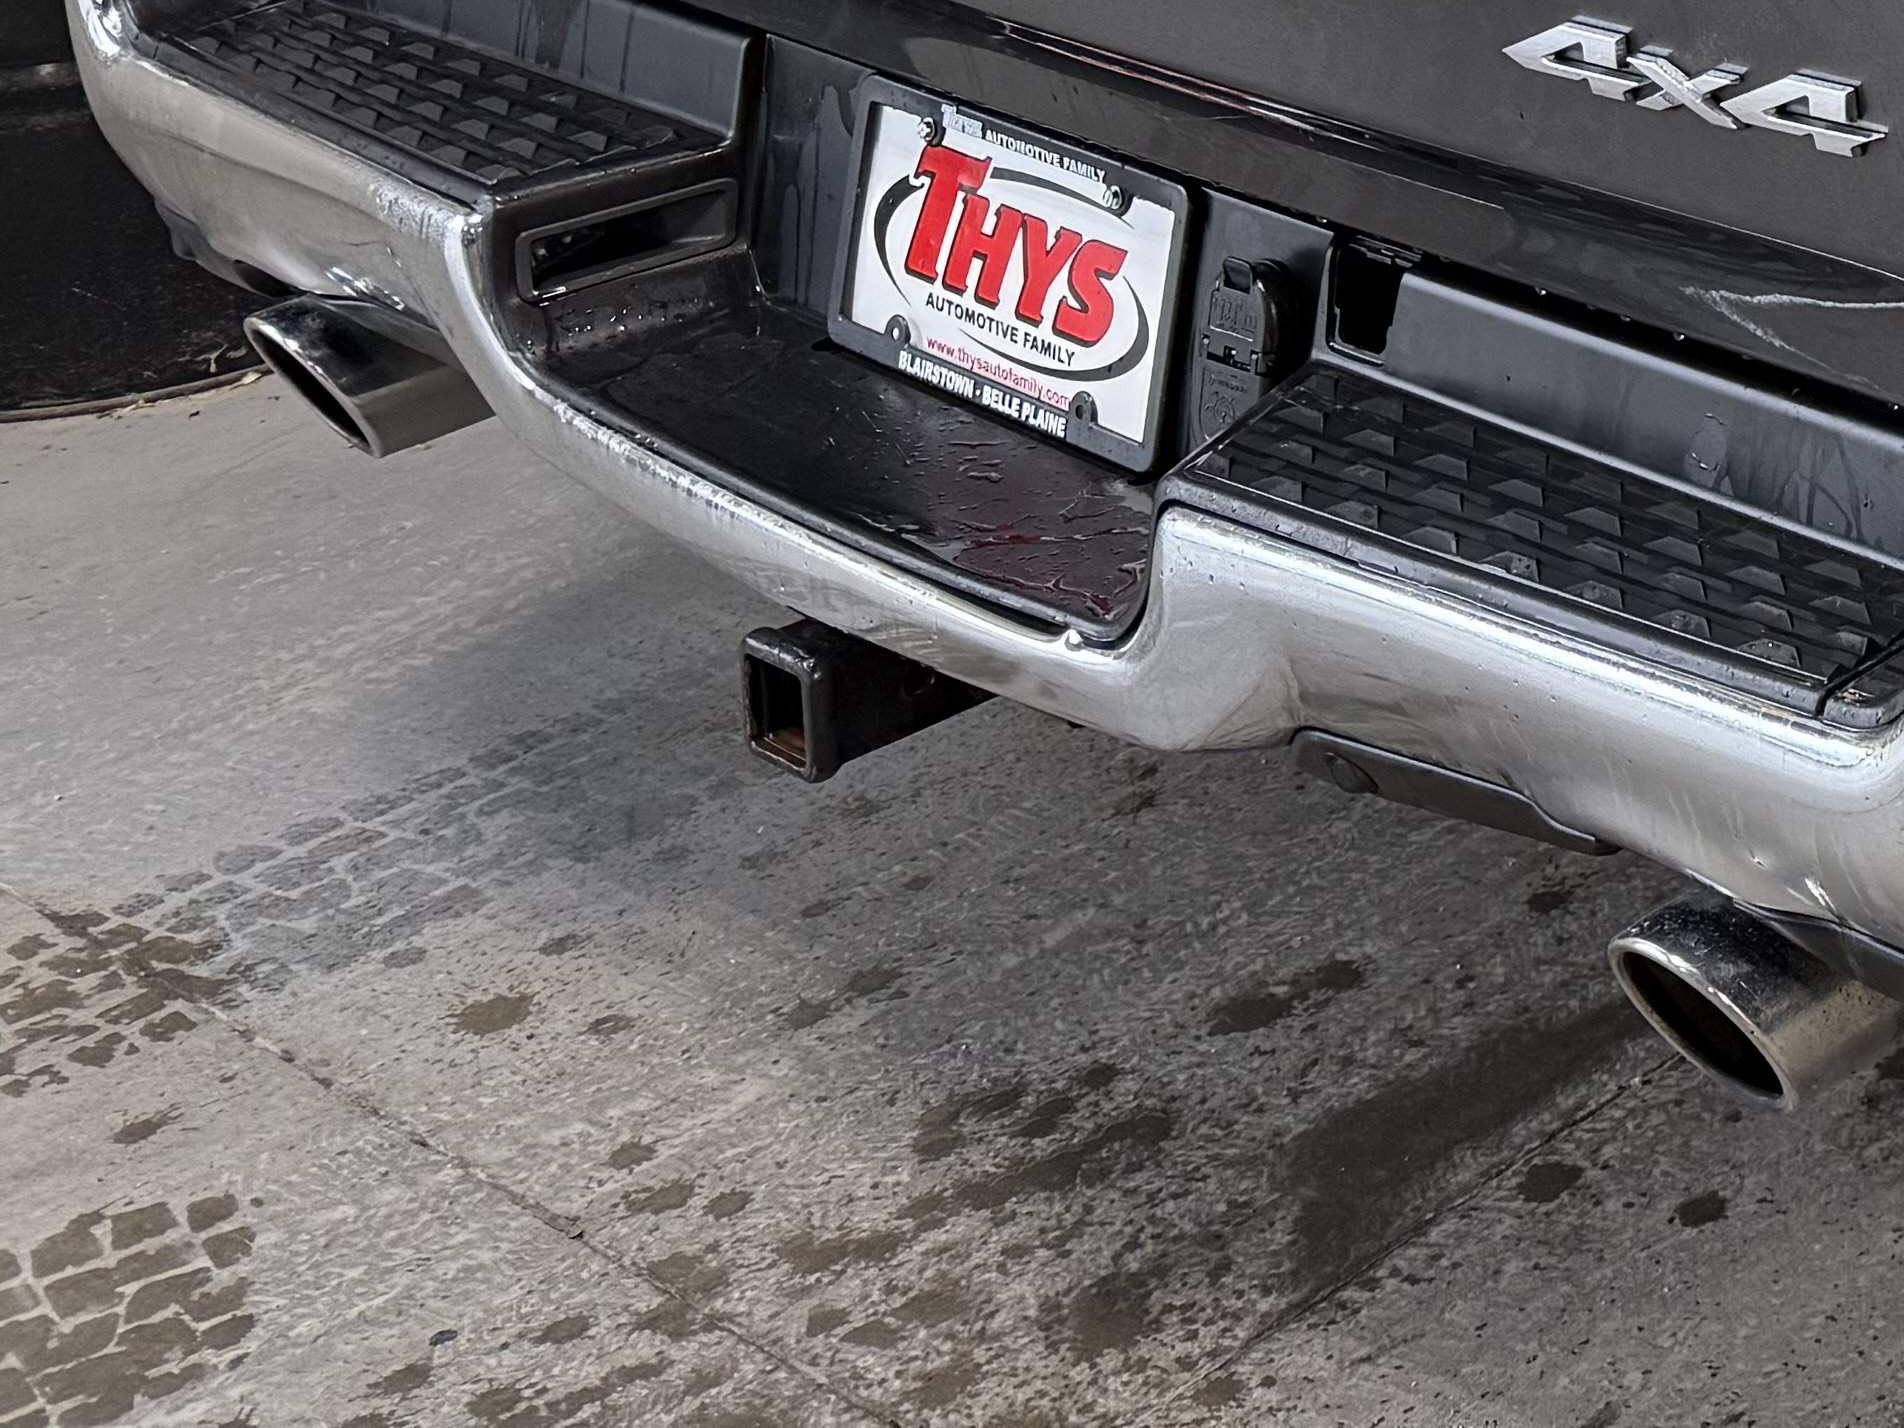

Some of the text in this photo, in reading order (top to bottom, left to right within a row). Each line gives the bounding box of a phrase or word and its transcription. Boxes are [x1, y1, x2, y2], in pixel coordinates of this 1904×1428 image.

[985, 129, 1061, 168] AUTOMOTIVE
[1062, 156, 1106, 184] FAMILY
[904, 143, 1129, 349] THYS
[925, 292, 1076, 367] AUTOMOTIVE FAMILY
[898, 350, 1067, 439] BLAIRSTOWN BELLE PLAINE
[926, 336, 1071, 411] www.thysautofamily.com
